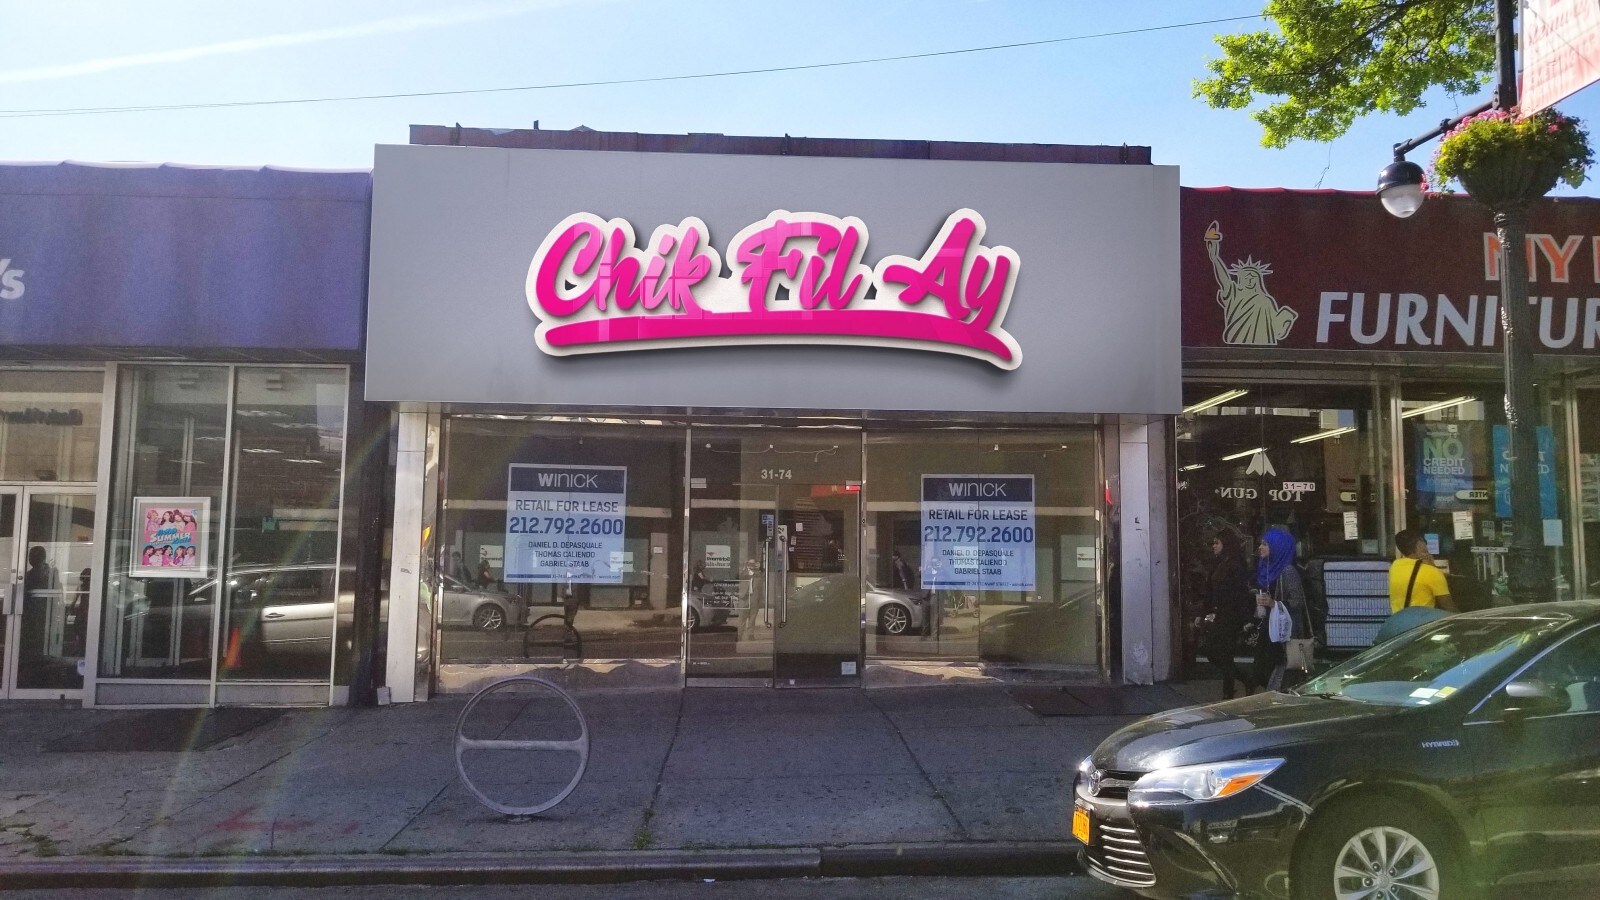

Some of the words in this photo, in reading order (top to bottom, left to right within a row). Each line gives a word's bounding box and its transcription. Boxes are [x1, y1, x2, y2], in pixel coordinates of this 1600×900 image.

[535, 221, 713, 316] Chik
[736, 219, 864, 313] Fil
[882, 217, 1011, 331] Ay
[1315, 291, 1600, 349] FURNIU
[1423, 437, 1464, 459] NO
[1423, 458, 1466, 468] CREDIT
[760, 469, 793, 480] 31-74
[1423, 466, 1466, 475] NEEDED
[537, 472, 599, 488] WINICK
[948, 482, 1007, 497] WINICK
[1284, 482, 1315, 490] 31-70
[515, 499, 554, 512] RETAIL
[556, 500, 580, 512] FOR
[582, 501, 619, 513] LEASE
[928, 509, 965, 520] RETAIL
[967, 509, 990, 520] FOR
[992, 509, 1028, 521] LEASE
[509, 516, 624, 535] 212.792.2600
[924, 525, 1034, 543] 212.792.2600
[528, 541, 552, 549] DANIEL
[560, 541, 603, 549] DEPASQUALE
[534, 550, 562, 558] THOMAS
[562, 551, 596, 559] CALIENDO
[942, 549, 965, 557] DANIEL
[539, 560, 568, 568] GABRIEL
[948, 558, 975, 566] THOMAS
[954, 567, 981, 575] GABRIEL
